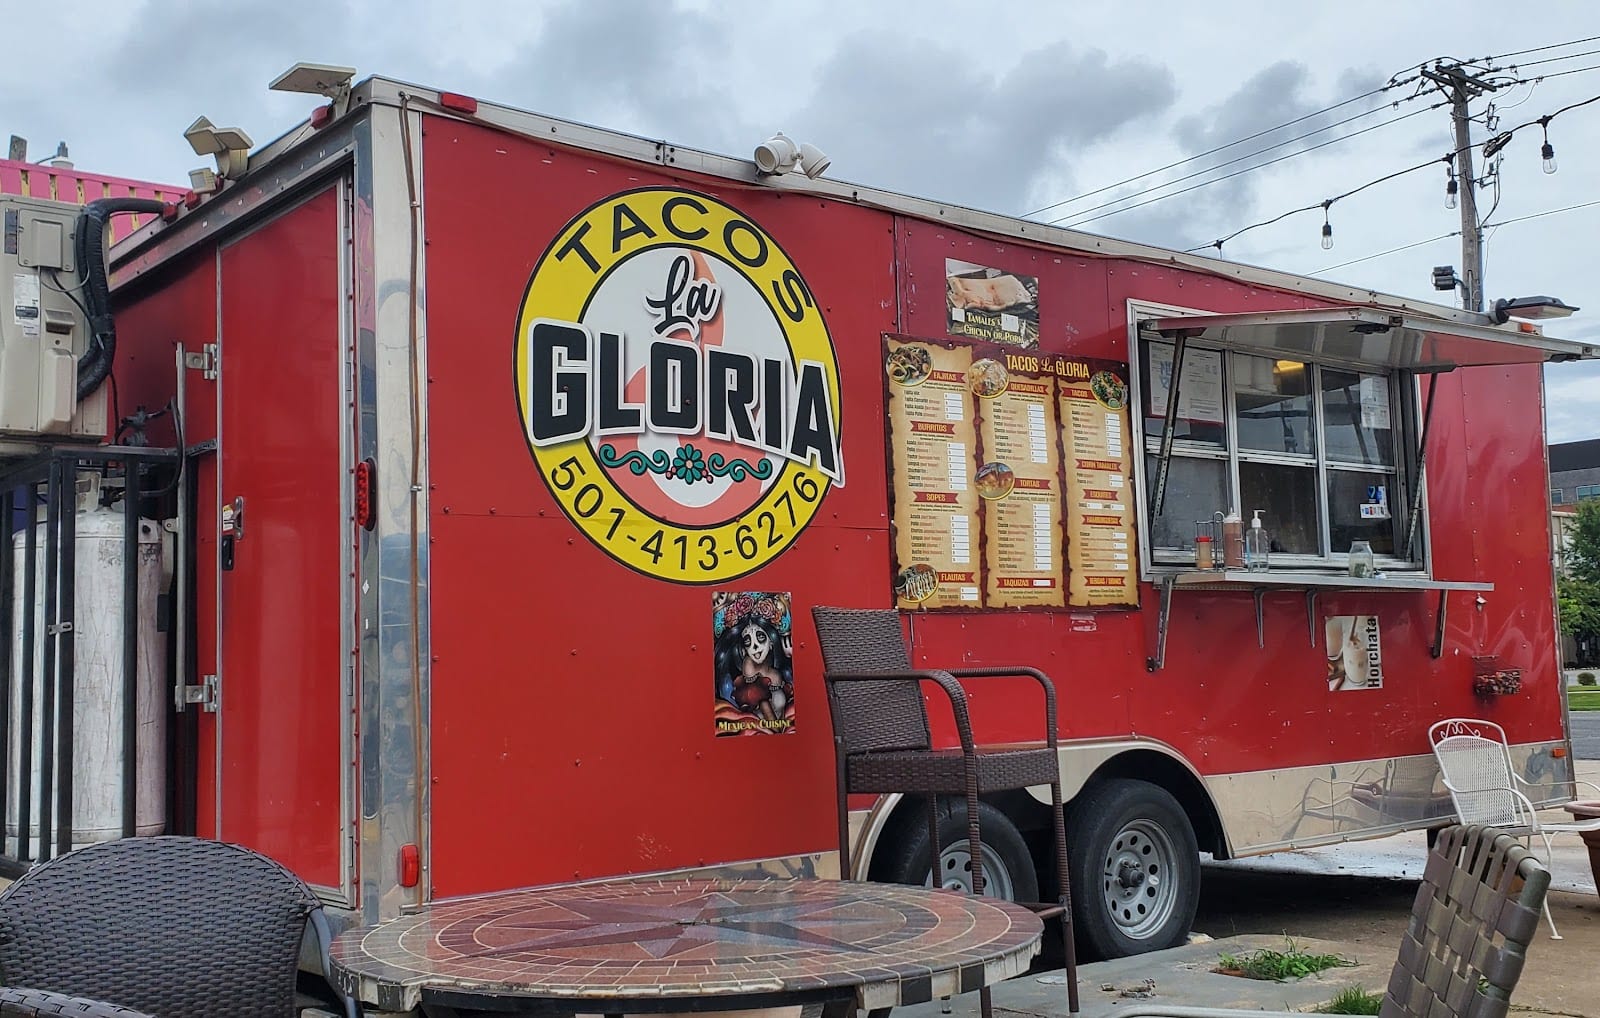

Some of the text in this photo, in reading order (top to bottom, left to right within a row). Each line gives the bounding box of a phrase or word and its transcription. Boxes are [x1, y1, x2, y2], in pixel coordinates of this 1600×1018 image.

[555, 197, 813, 323] TACOS
[646, 255, 717, 335] La
[964, 325, 992, 339] CHICKEN
[1004, 332, 1024, 344] PORK
[1005, 354, 1090, 378] TACOS La GLORIA
[934, 371, 957, 381] FAJITAS
[531, 322, 837, 473] GLORIA
[1071, 389, 1088, 398] TACOS
[917, 422, 947, 432] BURRITOS
[1020, 479, 1040, 488] TORTAS
[926, 493, 946, 502] SOPES
[550, 455, 820, 572] 501-413-6276
[941, 573, 966, 581] FLAUTAS
[1003, 578, 1029, 587] TAQUIZAS
[1366, 618, 1380, 688] Horchata
[718, 719, 792, 732] MEXICAN CUISINE
